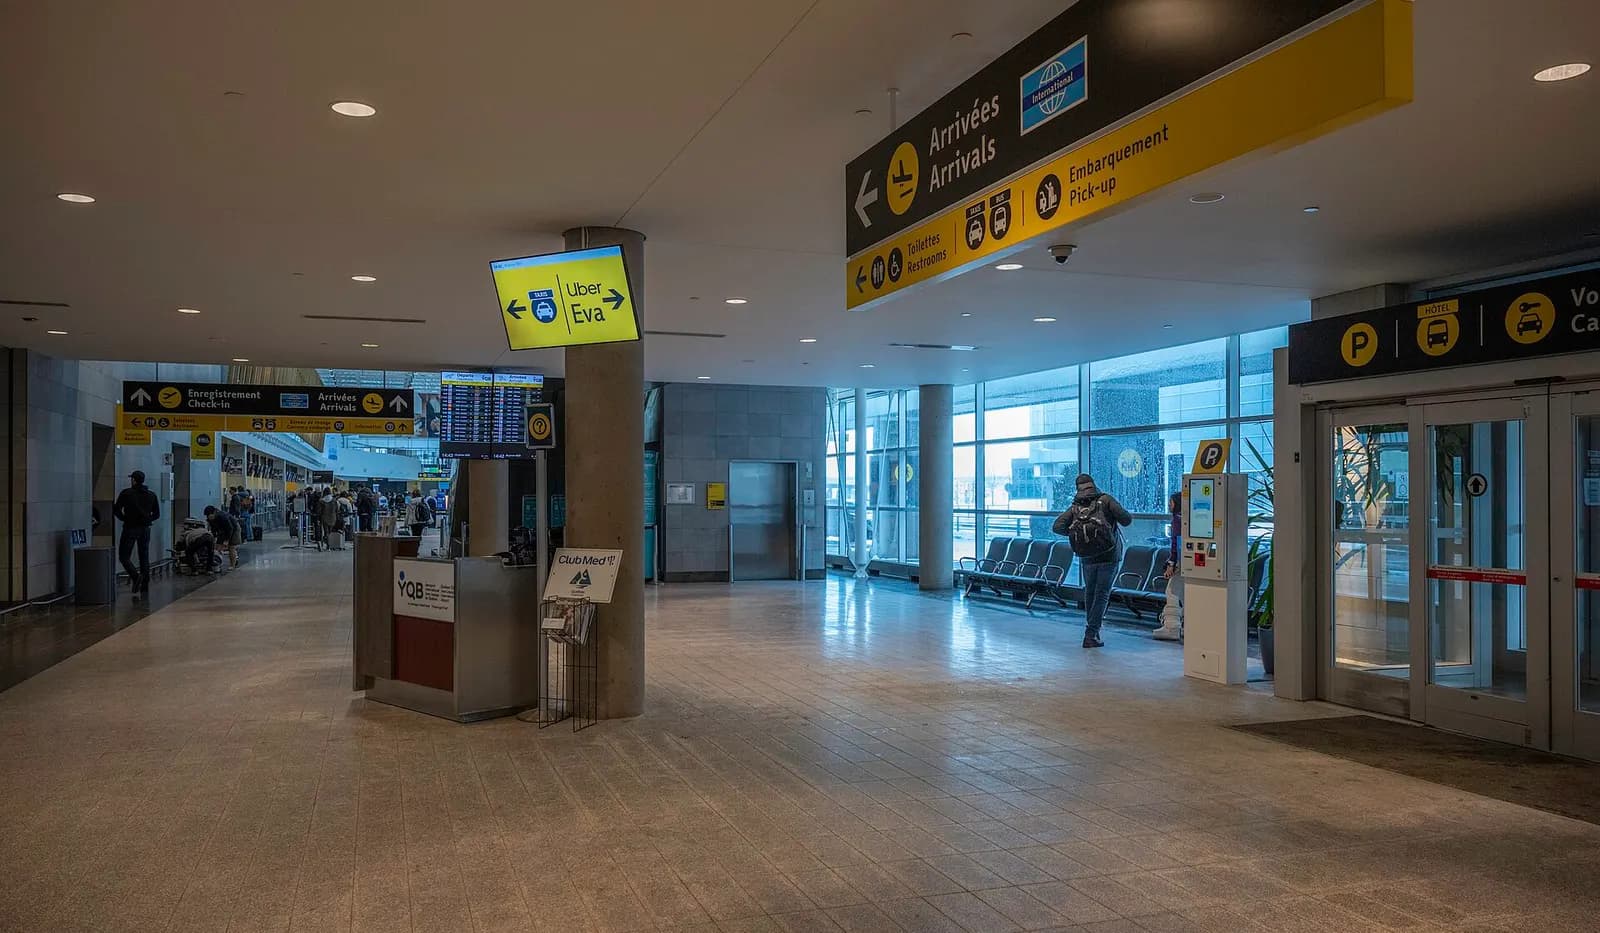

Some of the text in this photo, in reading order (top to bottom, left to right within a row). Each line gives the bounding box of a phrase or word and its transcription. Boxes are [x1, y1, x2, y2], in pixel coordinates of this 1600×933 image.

[1032, 72, 1074, 105] International
[928, 93, 1001, 157] Arrivées
[928, 134, 997, 193] Arrivals
[1069, 123, 1170, 184] Embarquement
[995, 193, 1005, 204] BUS
[1069, 176, 1117, 207] Pick-up
[969, 204, 982, 216] TAXIS
[907, 232, 941, 257] Toilettes
[907, 248, 948, 275] Restrooms
[566, 282, 602, 297] Uber
[1571, 287, 1600, 308] Vo
[570, 303, 606, 324] Eva
[1425, 303, 1450, 315] HÔTEL
[1571, 313, 1600, 334] Ca
[1351, 331, 1369, 359] P
[187, 388, 261, 400] Enregistrement
[187, 399, 231, 409] Check-in
[318, 392, 357, 402] Arrivées
[319, 402, 357, 412] Arrivals
[558, 555, 607, 566] Club Med
[398, 581, 424, 600] YQB
